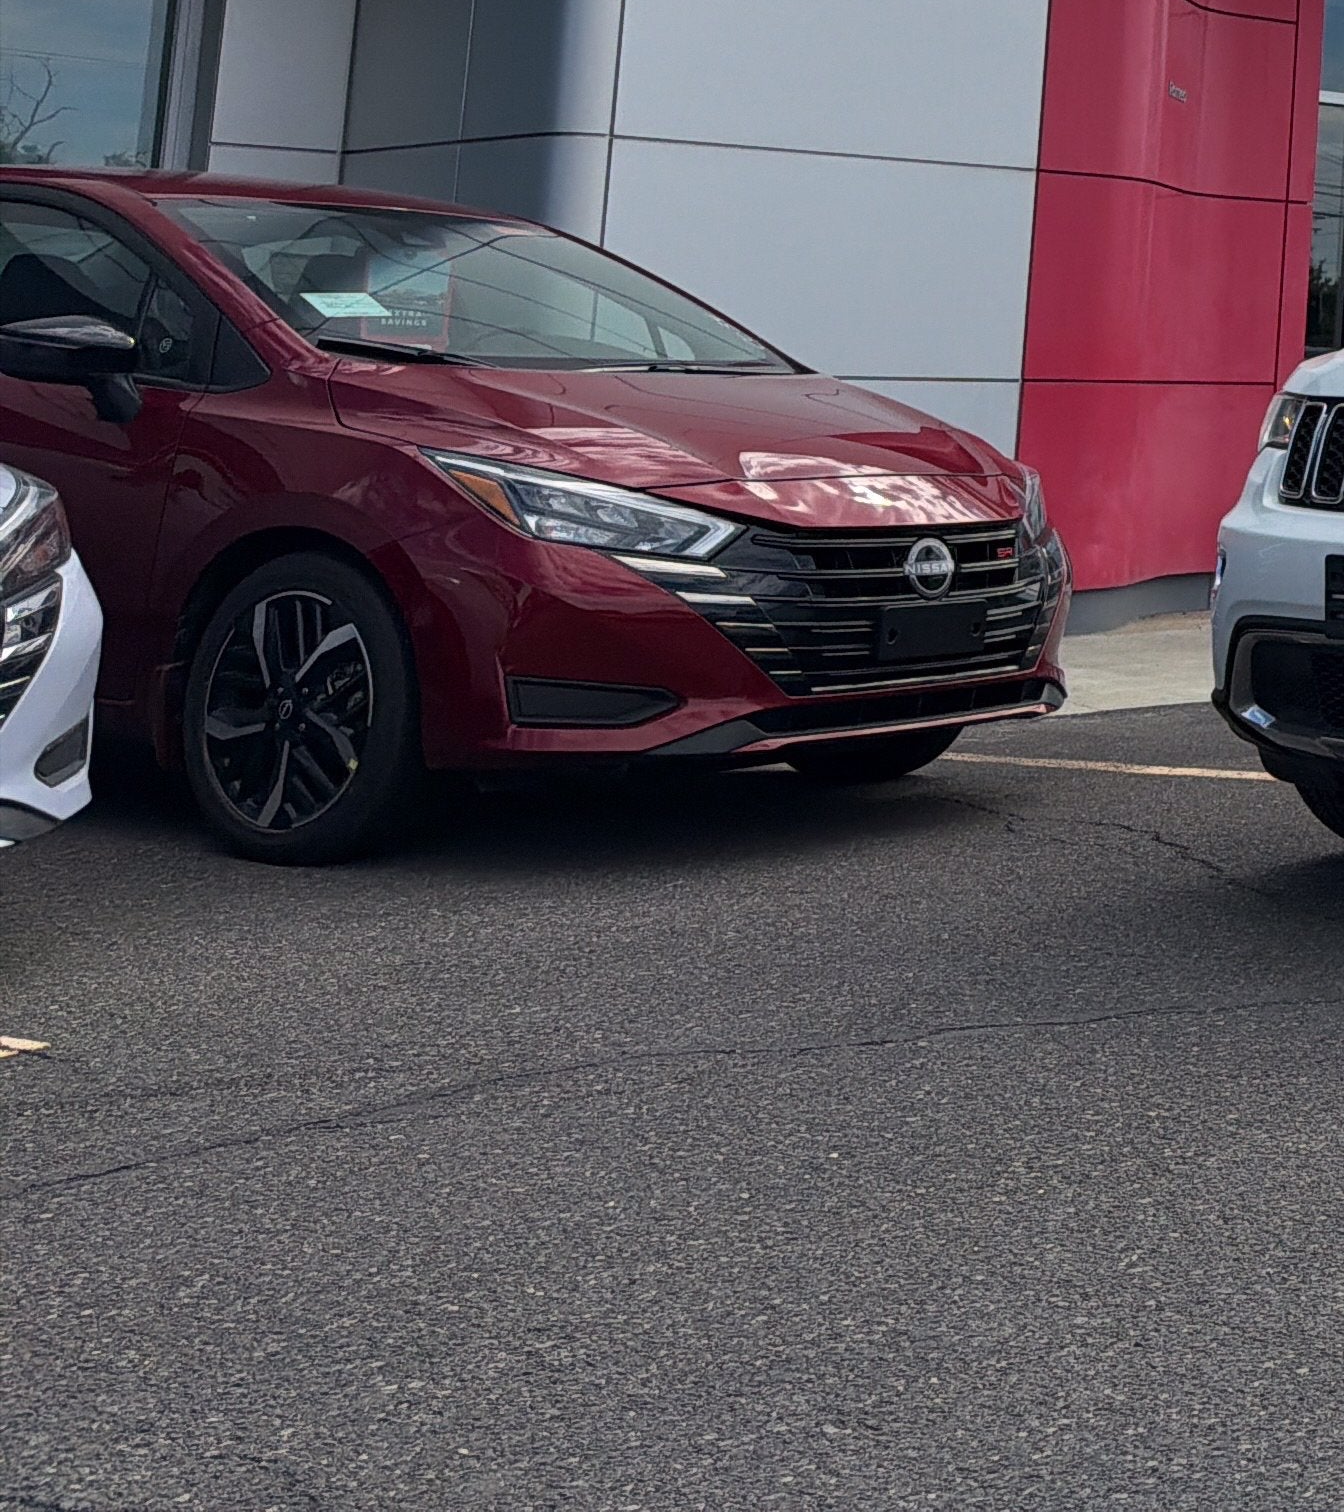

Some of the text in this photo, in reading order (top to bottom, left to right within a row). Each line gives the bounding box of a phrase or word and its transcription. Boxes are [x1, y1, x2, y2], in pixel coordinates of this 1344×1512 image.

[388, 309, 422, 317] XTRA
[380, 318, 427, 327] SAVINGS
[904, 562, 952, 575] NISSA
